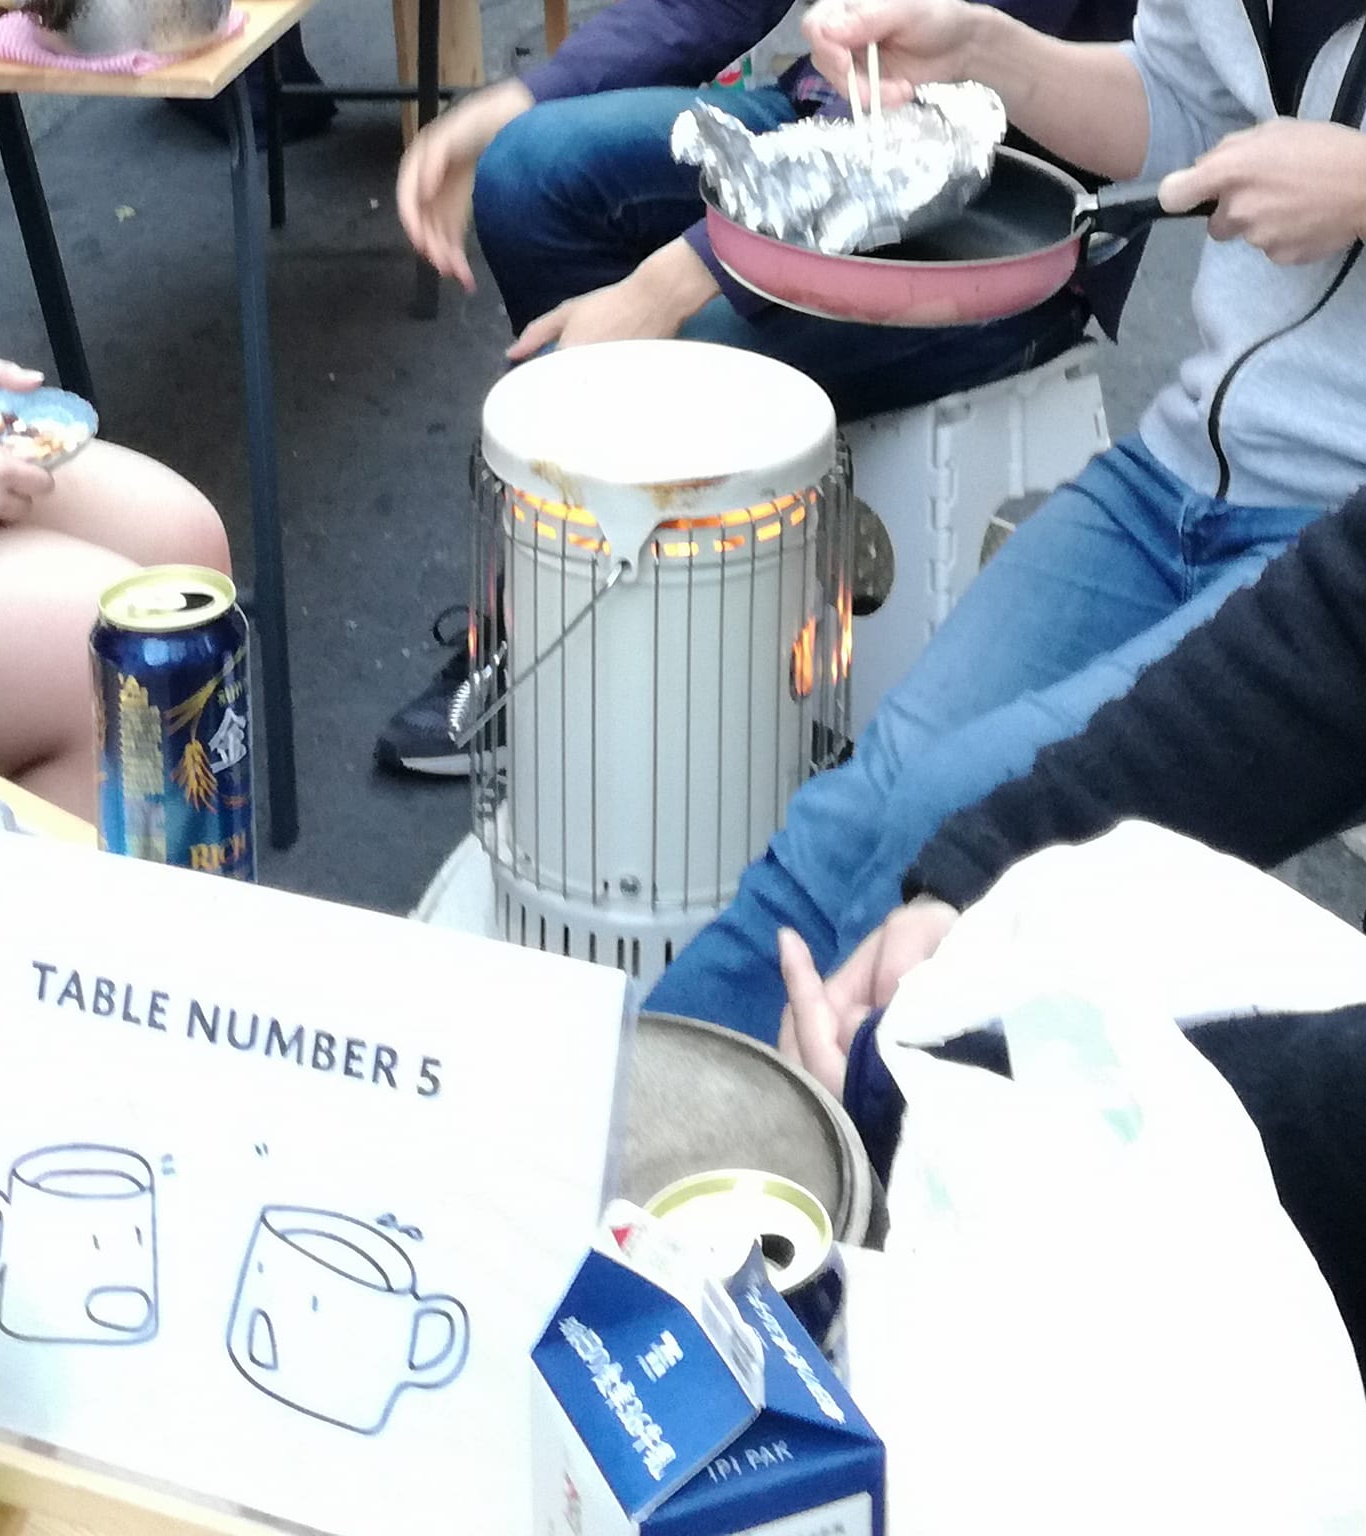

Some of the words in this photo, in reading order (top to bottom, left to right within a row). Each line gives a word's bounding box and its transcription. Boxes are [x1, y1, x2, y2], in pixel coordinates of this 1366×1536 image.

[32, 960, 170, 1032] TABLE
[186, 999, 400, 1090] NUMBER
[416, 1055, 443, 1098] 5
